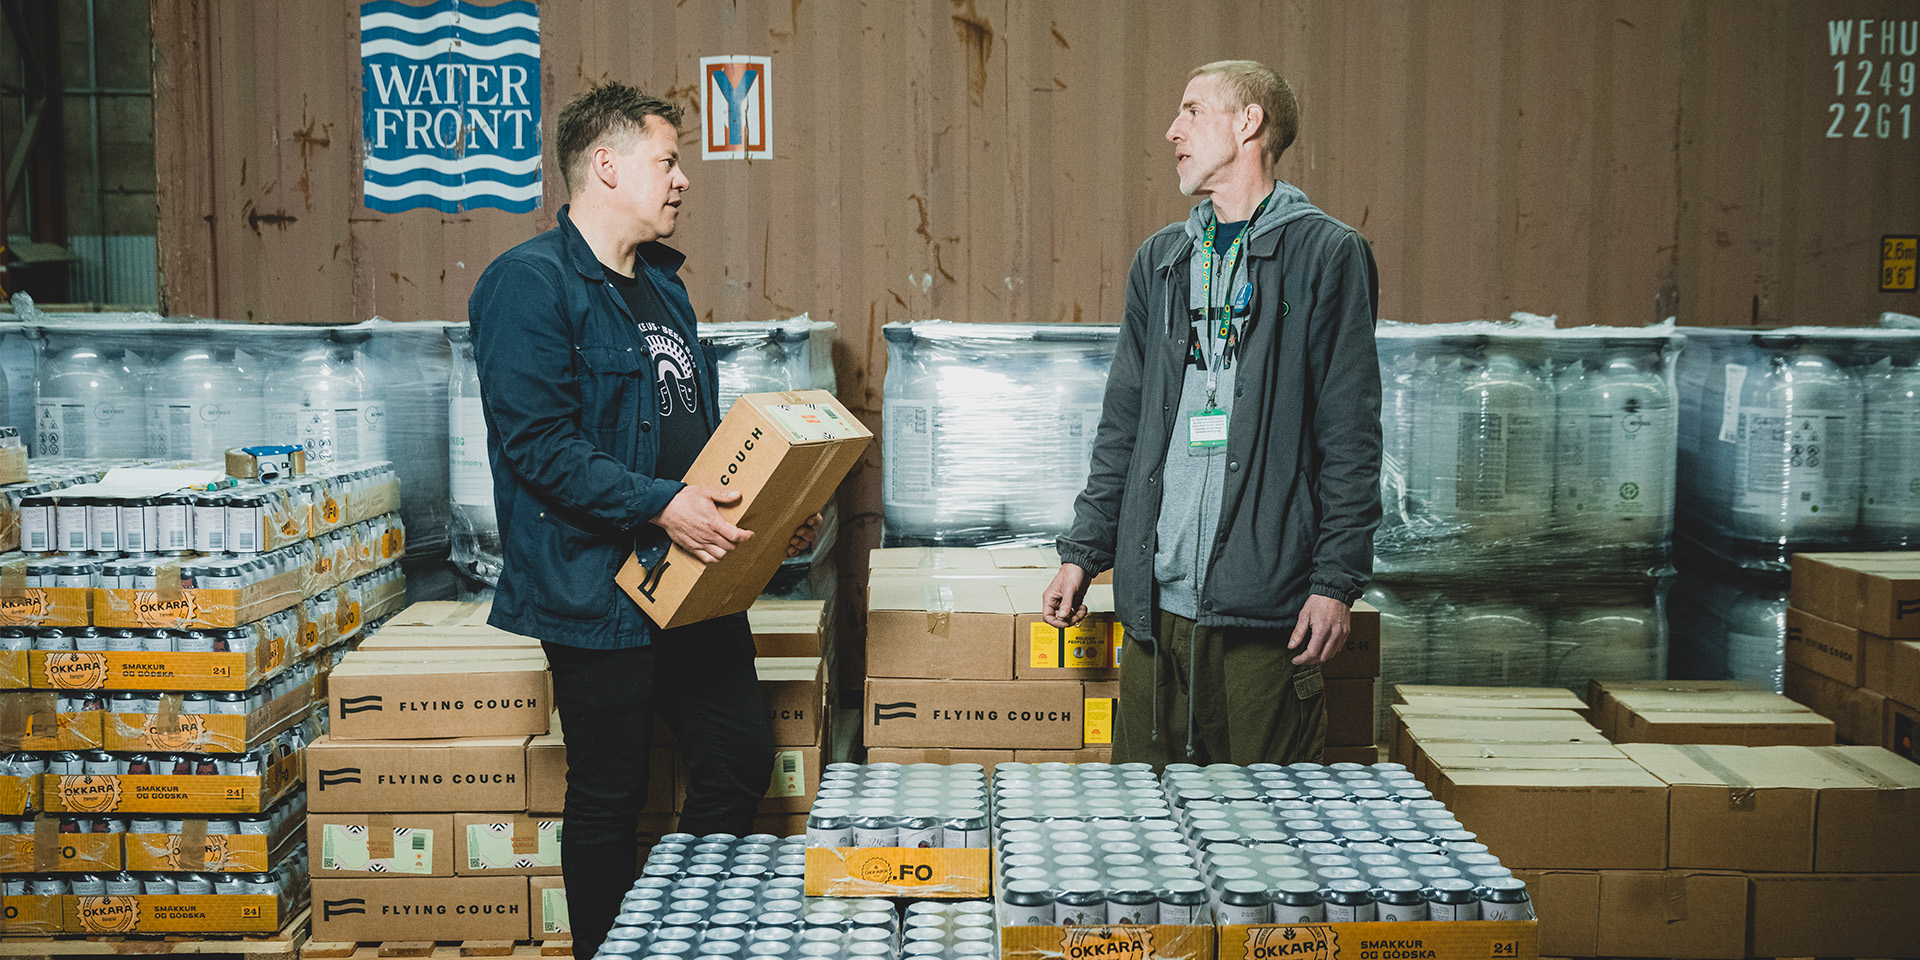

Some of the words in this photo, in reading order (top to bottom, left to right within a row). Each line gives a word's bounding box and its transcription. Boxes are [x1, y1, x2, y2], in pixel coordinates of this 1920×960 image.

[1827, 19, 1919, 56] WFHU
[369, 63, 530, 106] WATER
[1833, 60, 1916, 97] 1249
[1825, 102, 1911, 139] 22G1
[375, 109, 533, 149] FRONT
[720, 427, 763, 486] COUCH
[140, 600, 189, 613] OKKARA
[51, 662, 101, 674] OKKARA
[213, 667, 226, 675] 24
[400, 700, 465, 711] FLYING
[474, 698, 537, 710] COUCH
[933, 709, 998, 721] FLYING
[1007, 711, 1071, 722] COUCH
[378, 774, 443, 785] FLYING
[452, 773, 516, 784] COUCH
[64, 784, 115, 797] OKKARA
[227, 788, 240, 797] 24
[83, 905, 133, 918] OKKARA
[243, 907, 257, 916] 24
[382, 905, 446, 916] FLYING
[456, 904, 519, 915] COUCH
[1070, 940, 1144, 958] OKKARA
[1254, 940, 1328, 959] OKKARA
[1360, 940, 1423, 949] SMAKKUR
[1493, 942, 1513, 954] 24
[1360, 950, 1379, 960] OG
